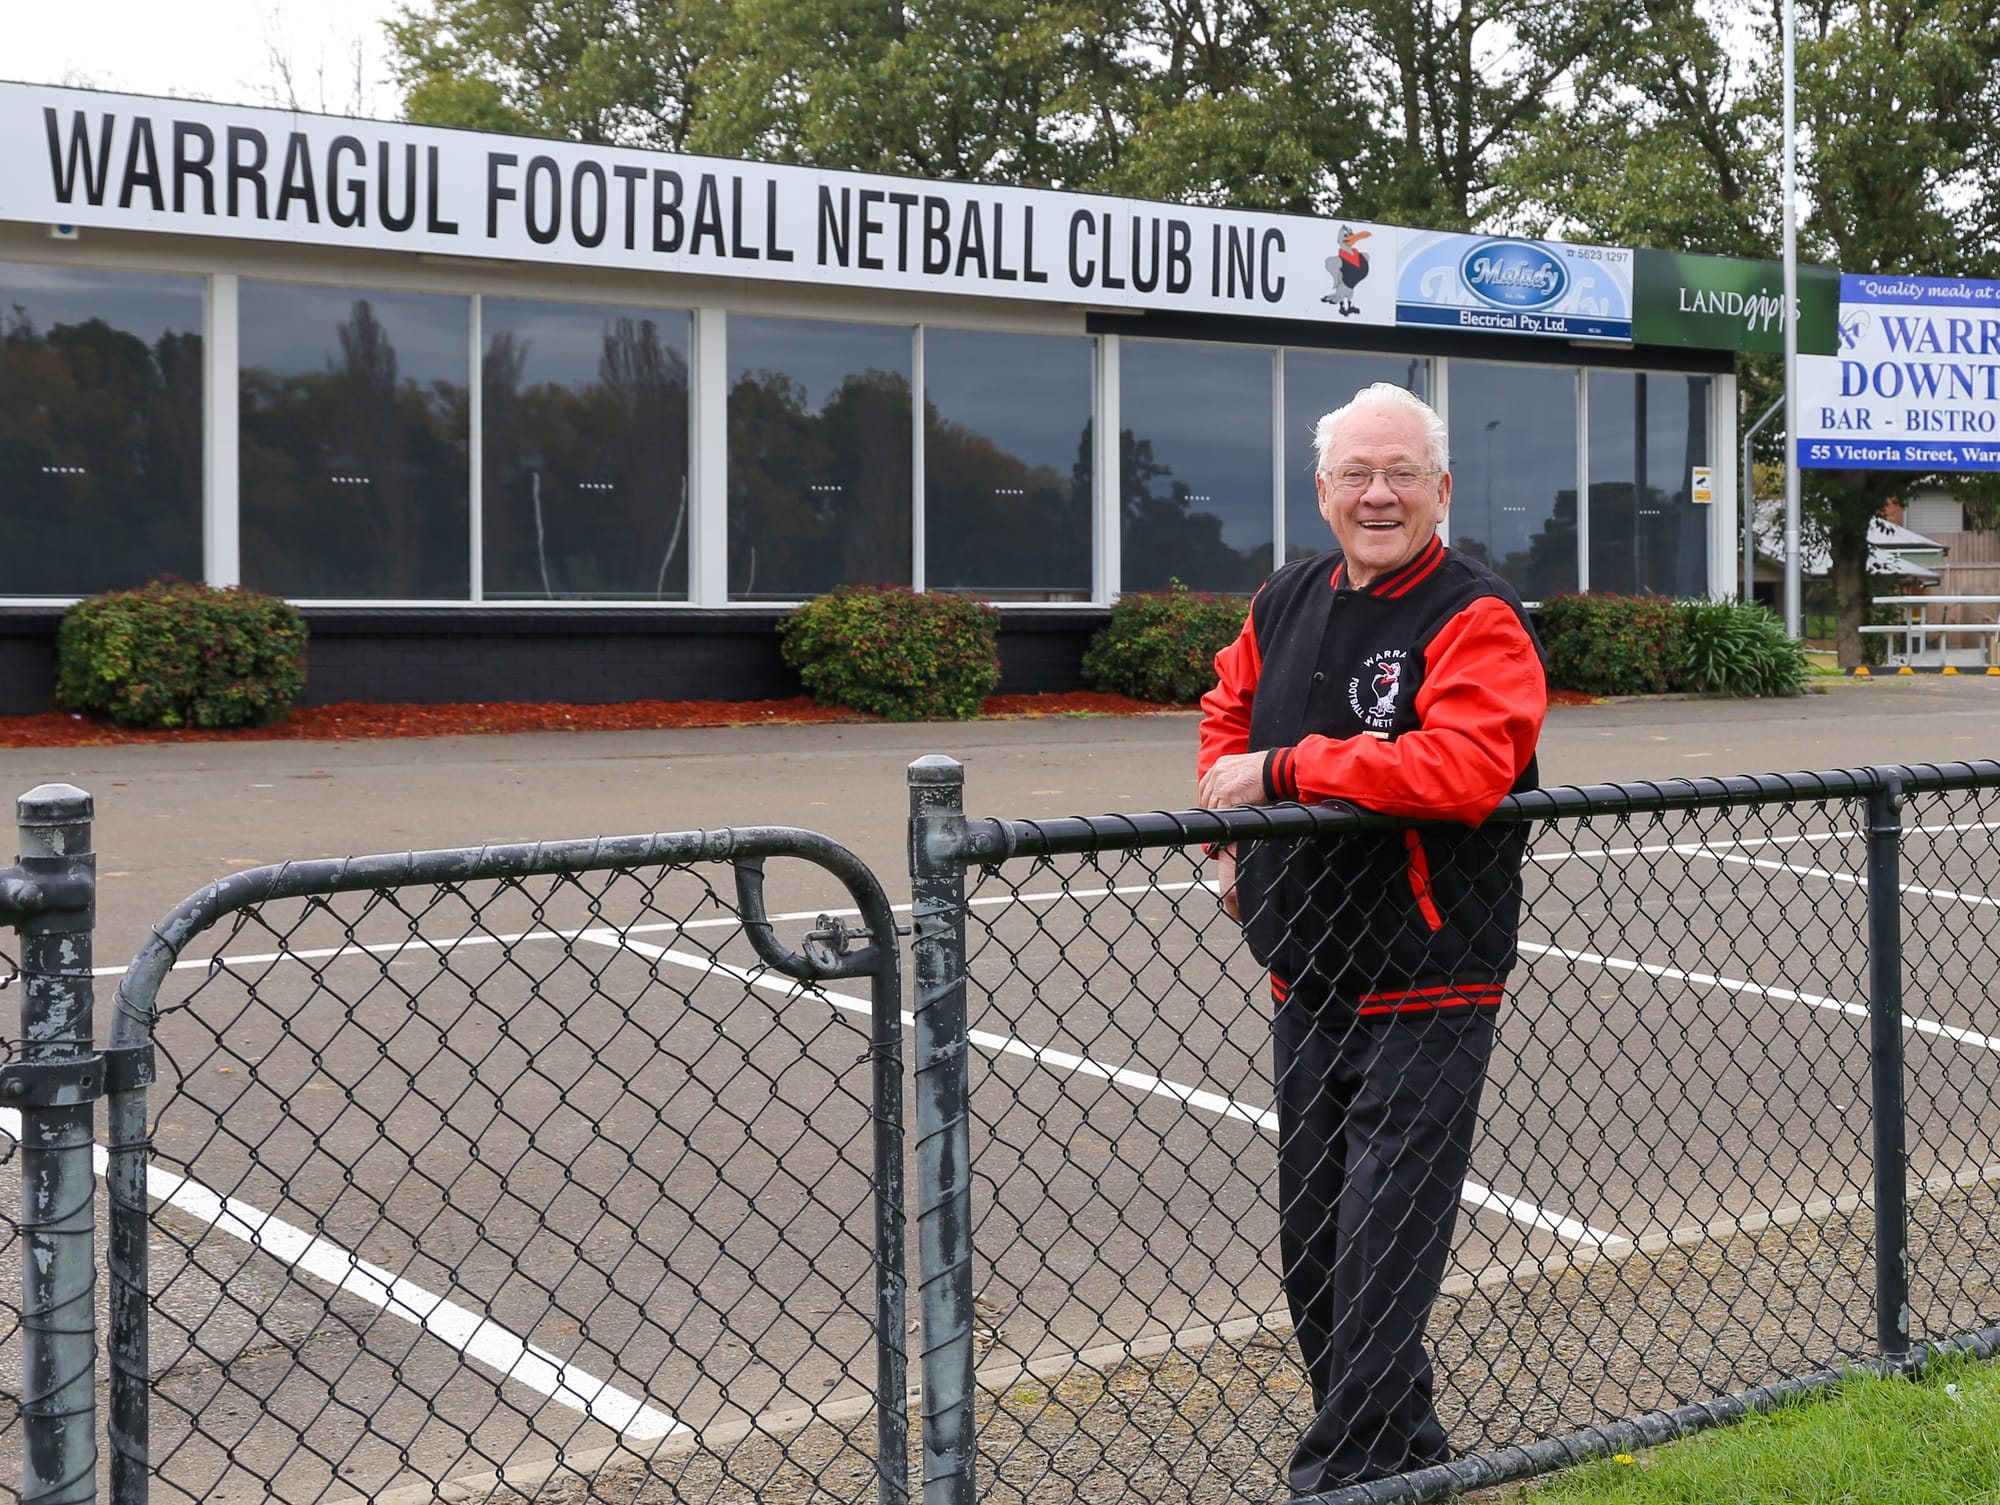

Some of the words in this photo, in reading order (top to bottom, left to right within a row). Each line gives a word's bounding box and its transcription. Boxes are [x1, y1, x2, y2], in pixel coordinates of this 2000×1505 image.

[43, 107, 459, 235] WARRAGUL
[486, 151, 793, 262] FOOTBALL
[817, 185, 1048, 283] NETBALL
[1067, 208, 1192, 295] CLUB
[1210, 223, 1286, 304] INC
[1577, 250, 1602, 260] 5623
[1606, 252, 1629, 262] 1297
[1471, 257, 1560, 296] Malady
[1928, 284, 1973, 299] meals
[1974, 286, 1994, 298] at
[1459, 310, 1517, 329] Electrical
[1520, 316, 1542, 333] Pty.
[1544, 317, 1568, 332] Ltd.
[1838, 360, 2000, 400] DOWNT
[1820, 407, 1872, 430] BAR
[1906, 409, 1996, 432] BISTRO
[1810, 444, 1830, 460] 55
[1835, 445, 1900, 461] Victoria
[1905, 446, 1958, 464] Street,
[1348, 677, 1365, 718] FOOTBALL
[1364, 716, 1371, 724] &
